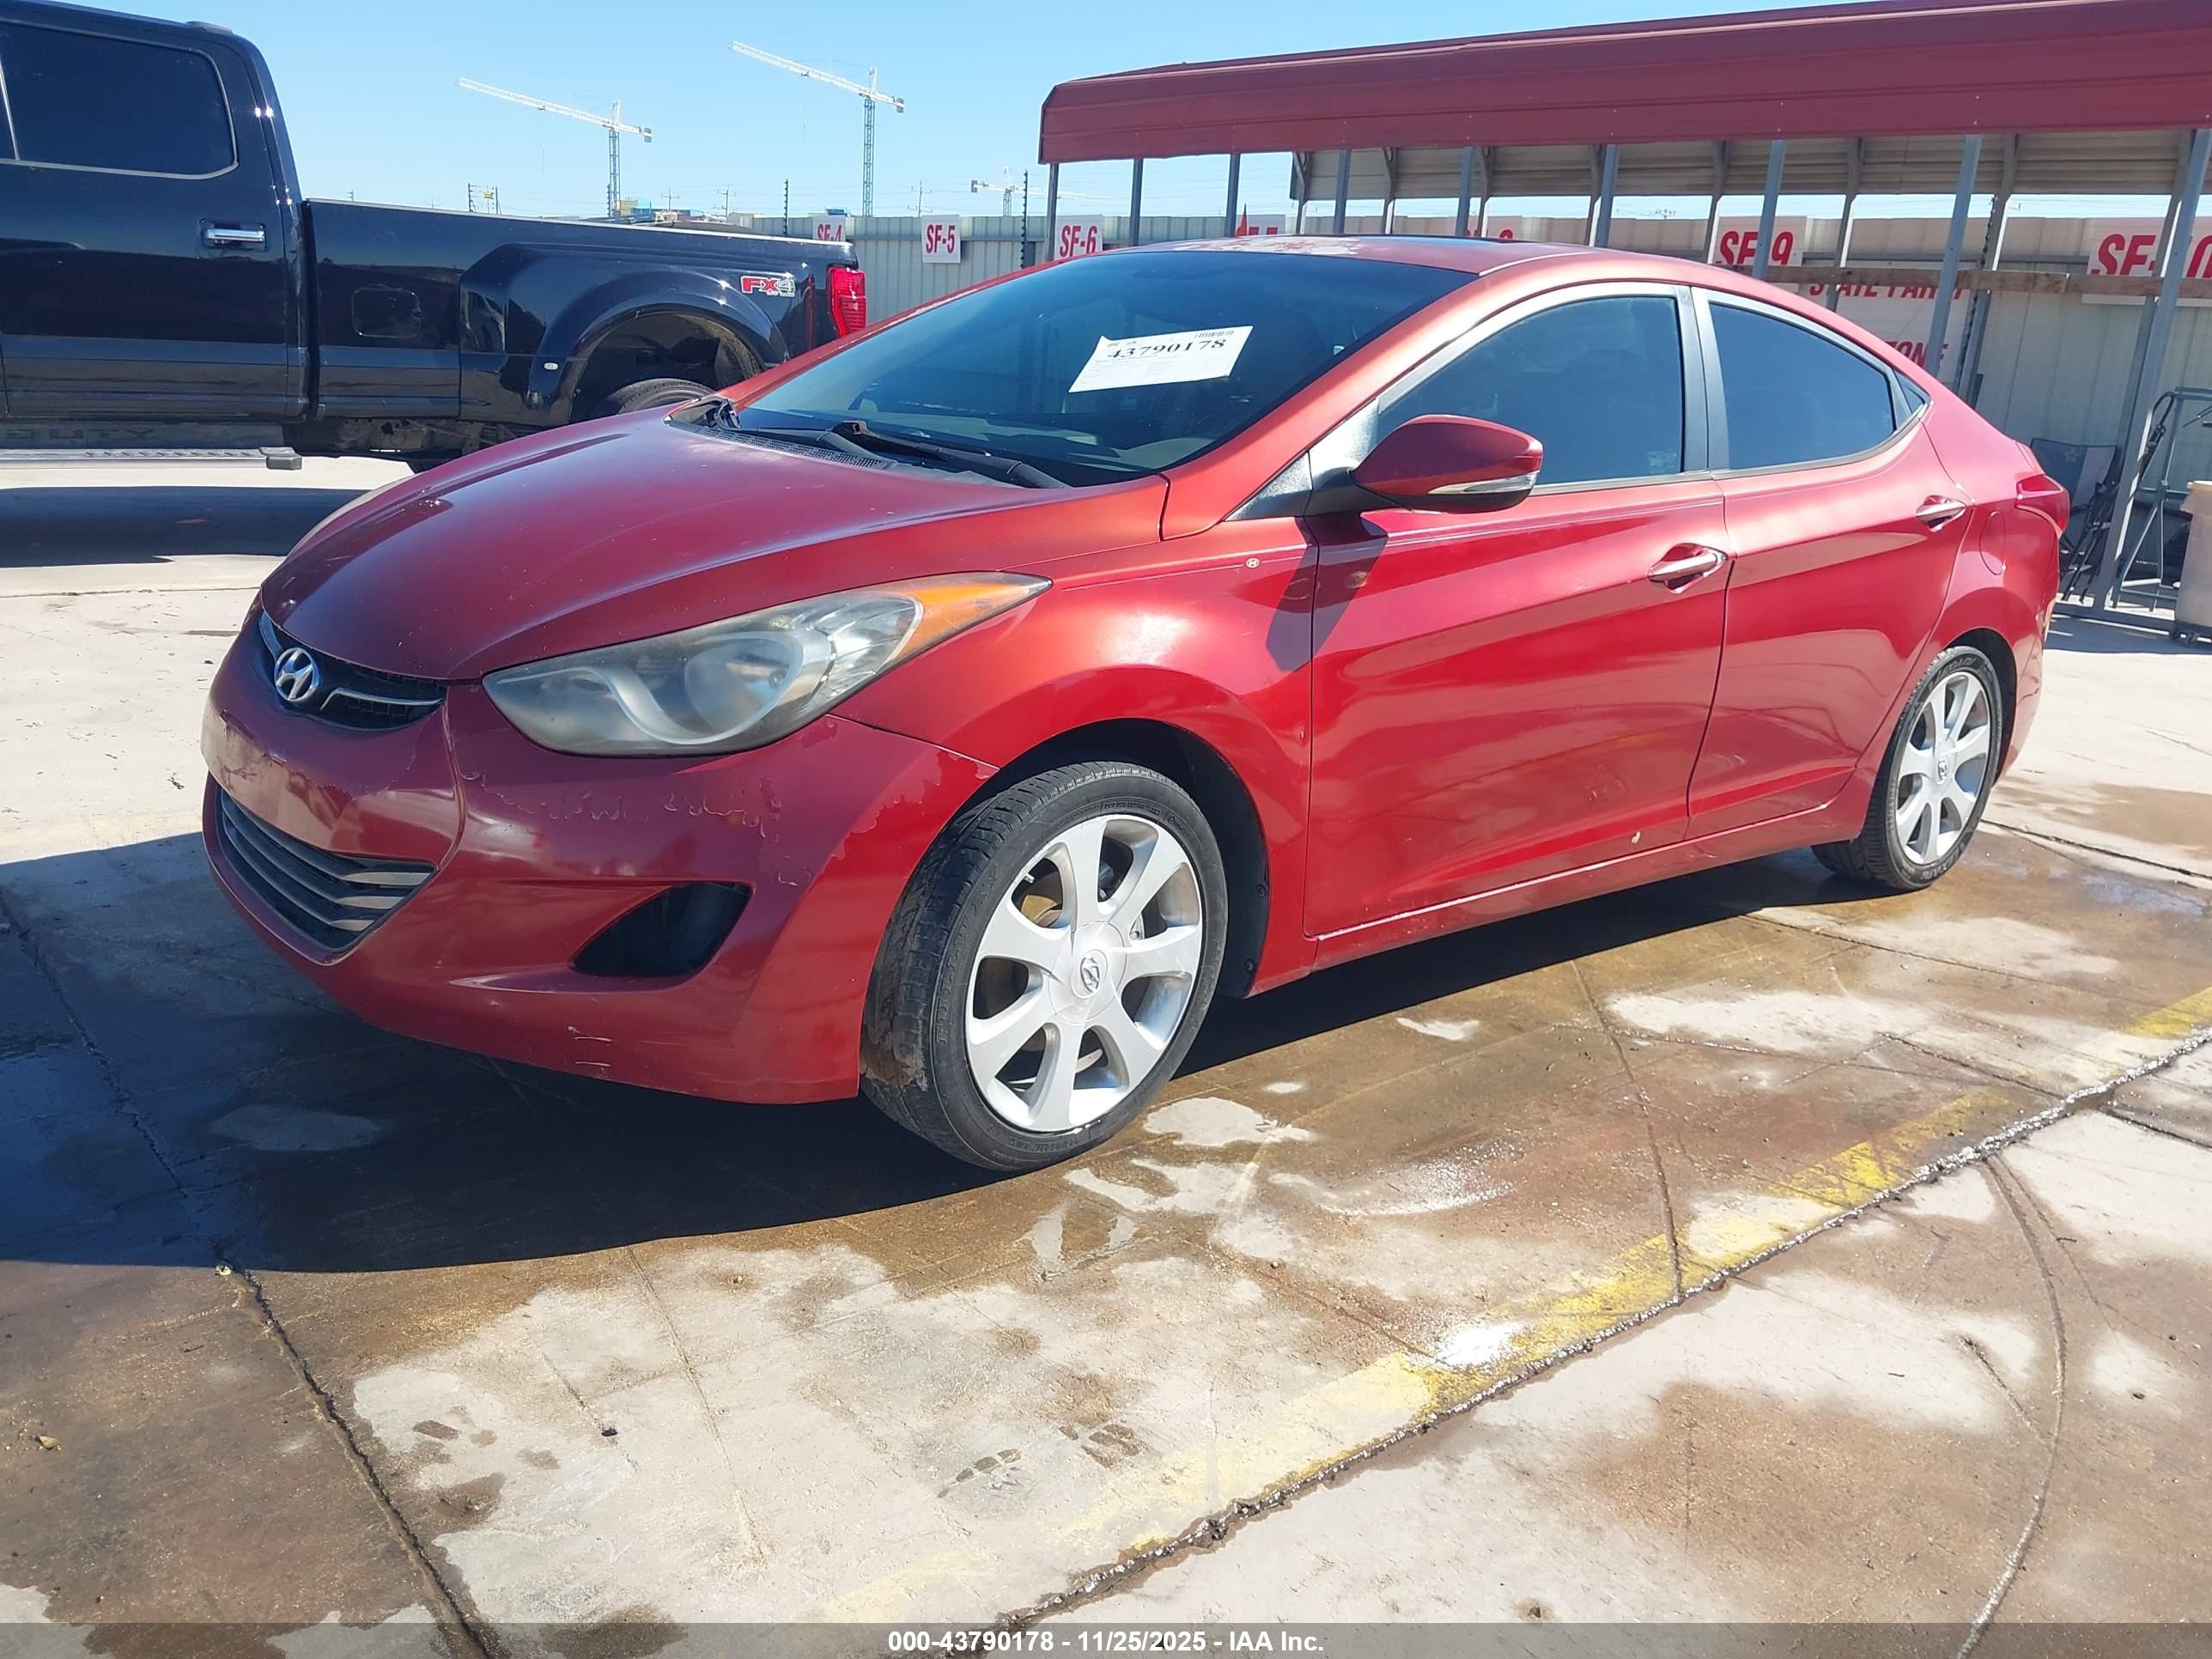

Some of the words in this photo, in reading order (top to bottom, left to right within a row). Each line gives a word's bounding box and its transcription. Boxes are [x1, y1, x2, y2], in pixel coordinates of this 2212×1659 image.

[926, 224, 956, 254] SF-5
[1060, 225, 1097, 257] SF-6
[741, 276, 795, 295] FX4
[1107, 339, 1227, 358] 43790178
